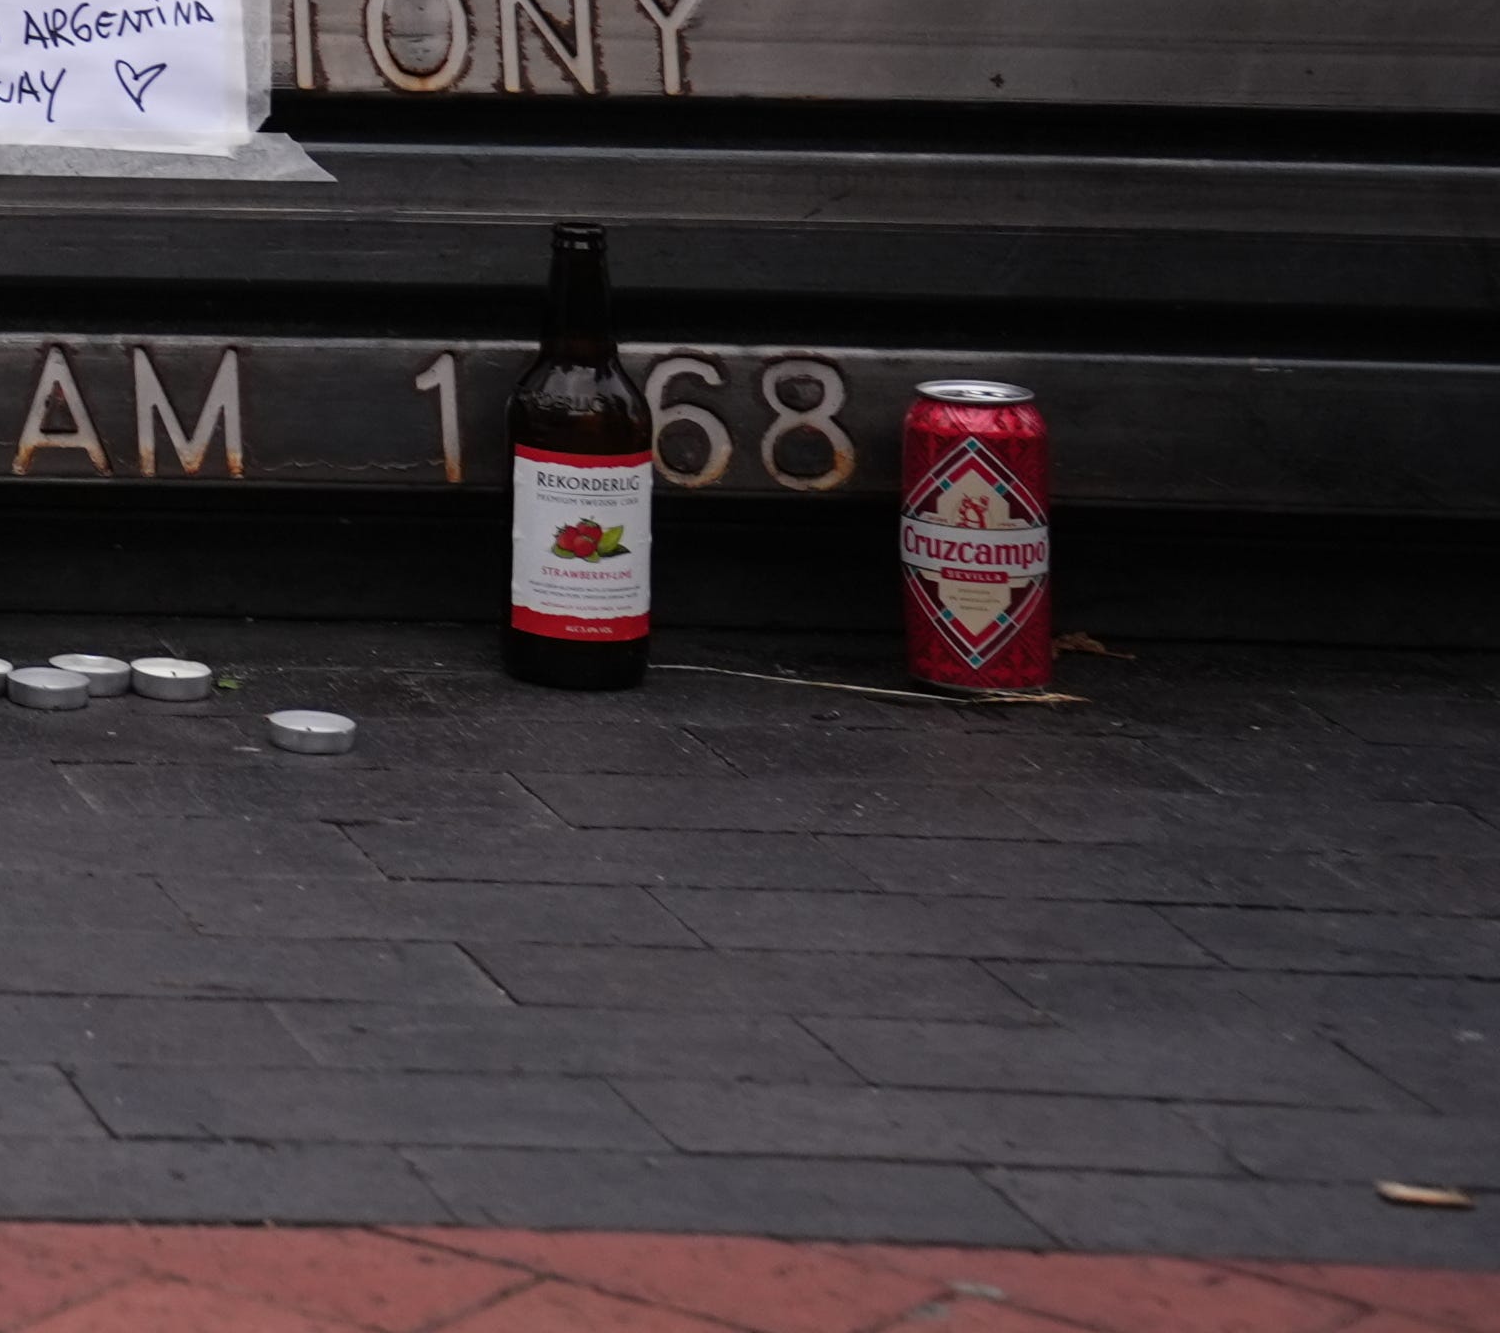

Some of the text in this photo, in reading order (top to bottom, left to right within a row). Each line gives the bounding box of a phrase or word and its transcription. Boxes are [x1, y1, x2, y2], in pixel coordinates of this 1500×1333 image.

[414, 347, 858, 491] 168
[536, 471, 640, 492] REKORDERLIG
[903, 525, 1046, 570] Cruzcampo
[945, 570, 1002, 582] SEVILLA
